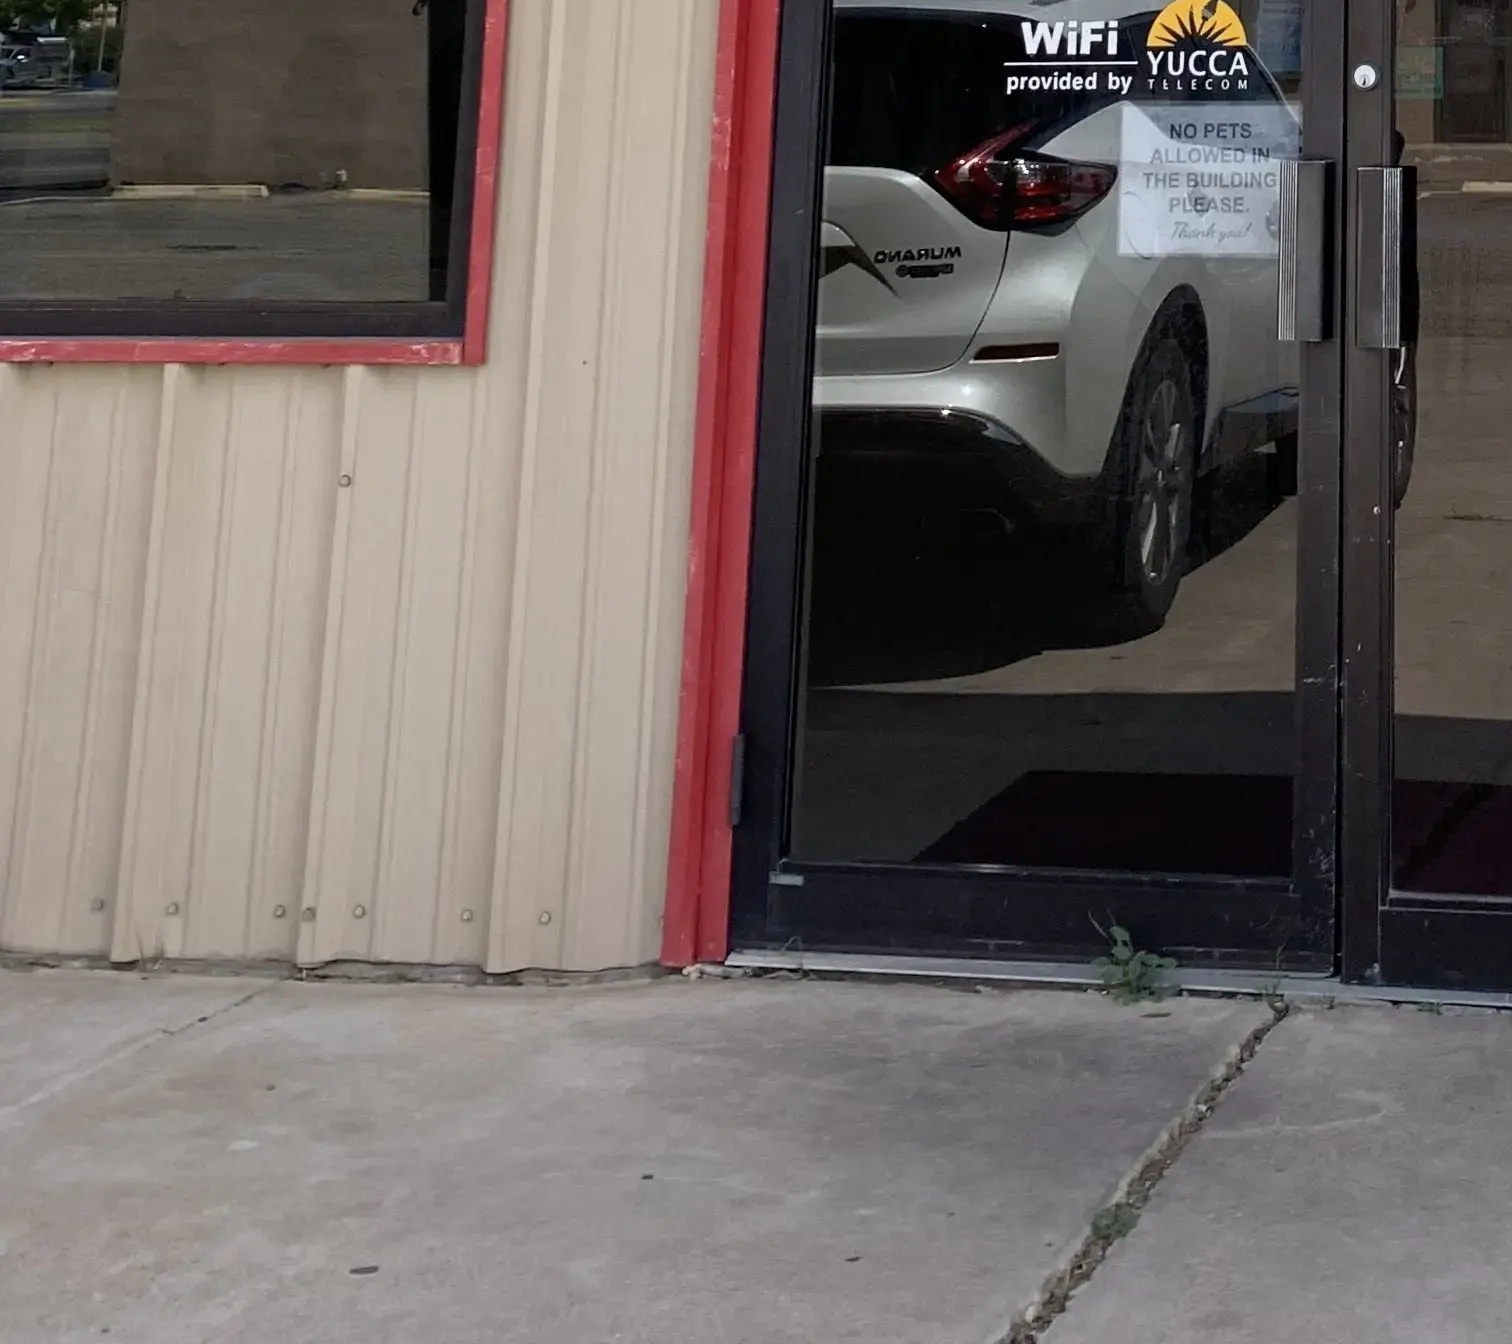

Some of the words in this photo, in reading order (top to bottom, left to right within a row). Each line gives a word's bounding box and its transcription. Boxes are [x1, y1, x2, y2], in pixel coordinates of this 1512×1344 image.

[1020, 19, 1119, 57] WiFi
[1146, 49, 1250, 77] YUCCA
[1005, 70, 1098, 95] provided
[1107, 70, 1133, 95] by
[1147, 78, 1250, 91] TELECOM
[1169, 122, 1198, 140] NO
[1203, 121, 1253, 140] PETS
[1150, 146, 1246, 165] ALLOWED
[1252, 146, 1271, 164] IN
[1143, 172, 1180, 189] THE
[1186, 171, 1277, 190] BUILDING
[1168, 196, 1252, 215] PLEASE.
[1170, 220, 1215, 242] Thank
[1217, 221, 1253, 244] you!
